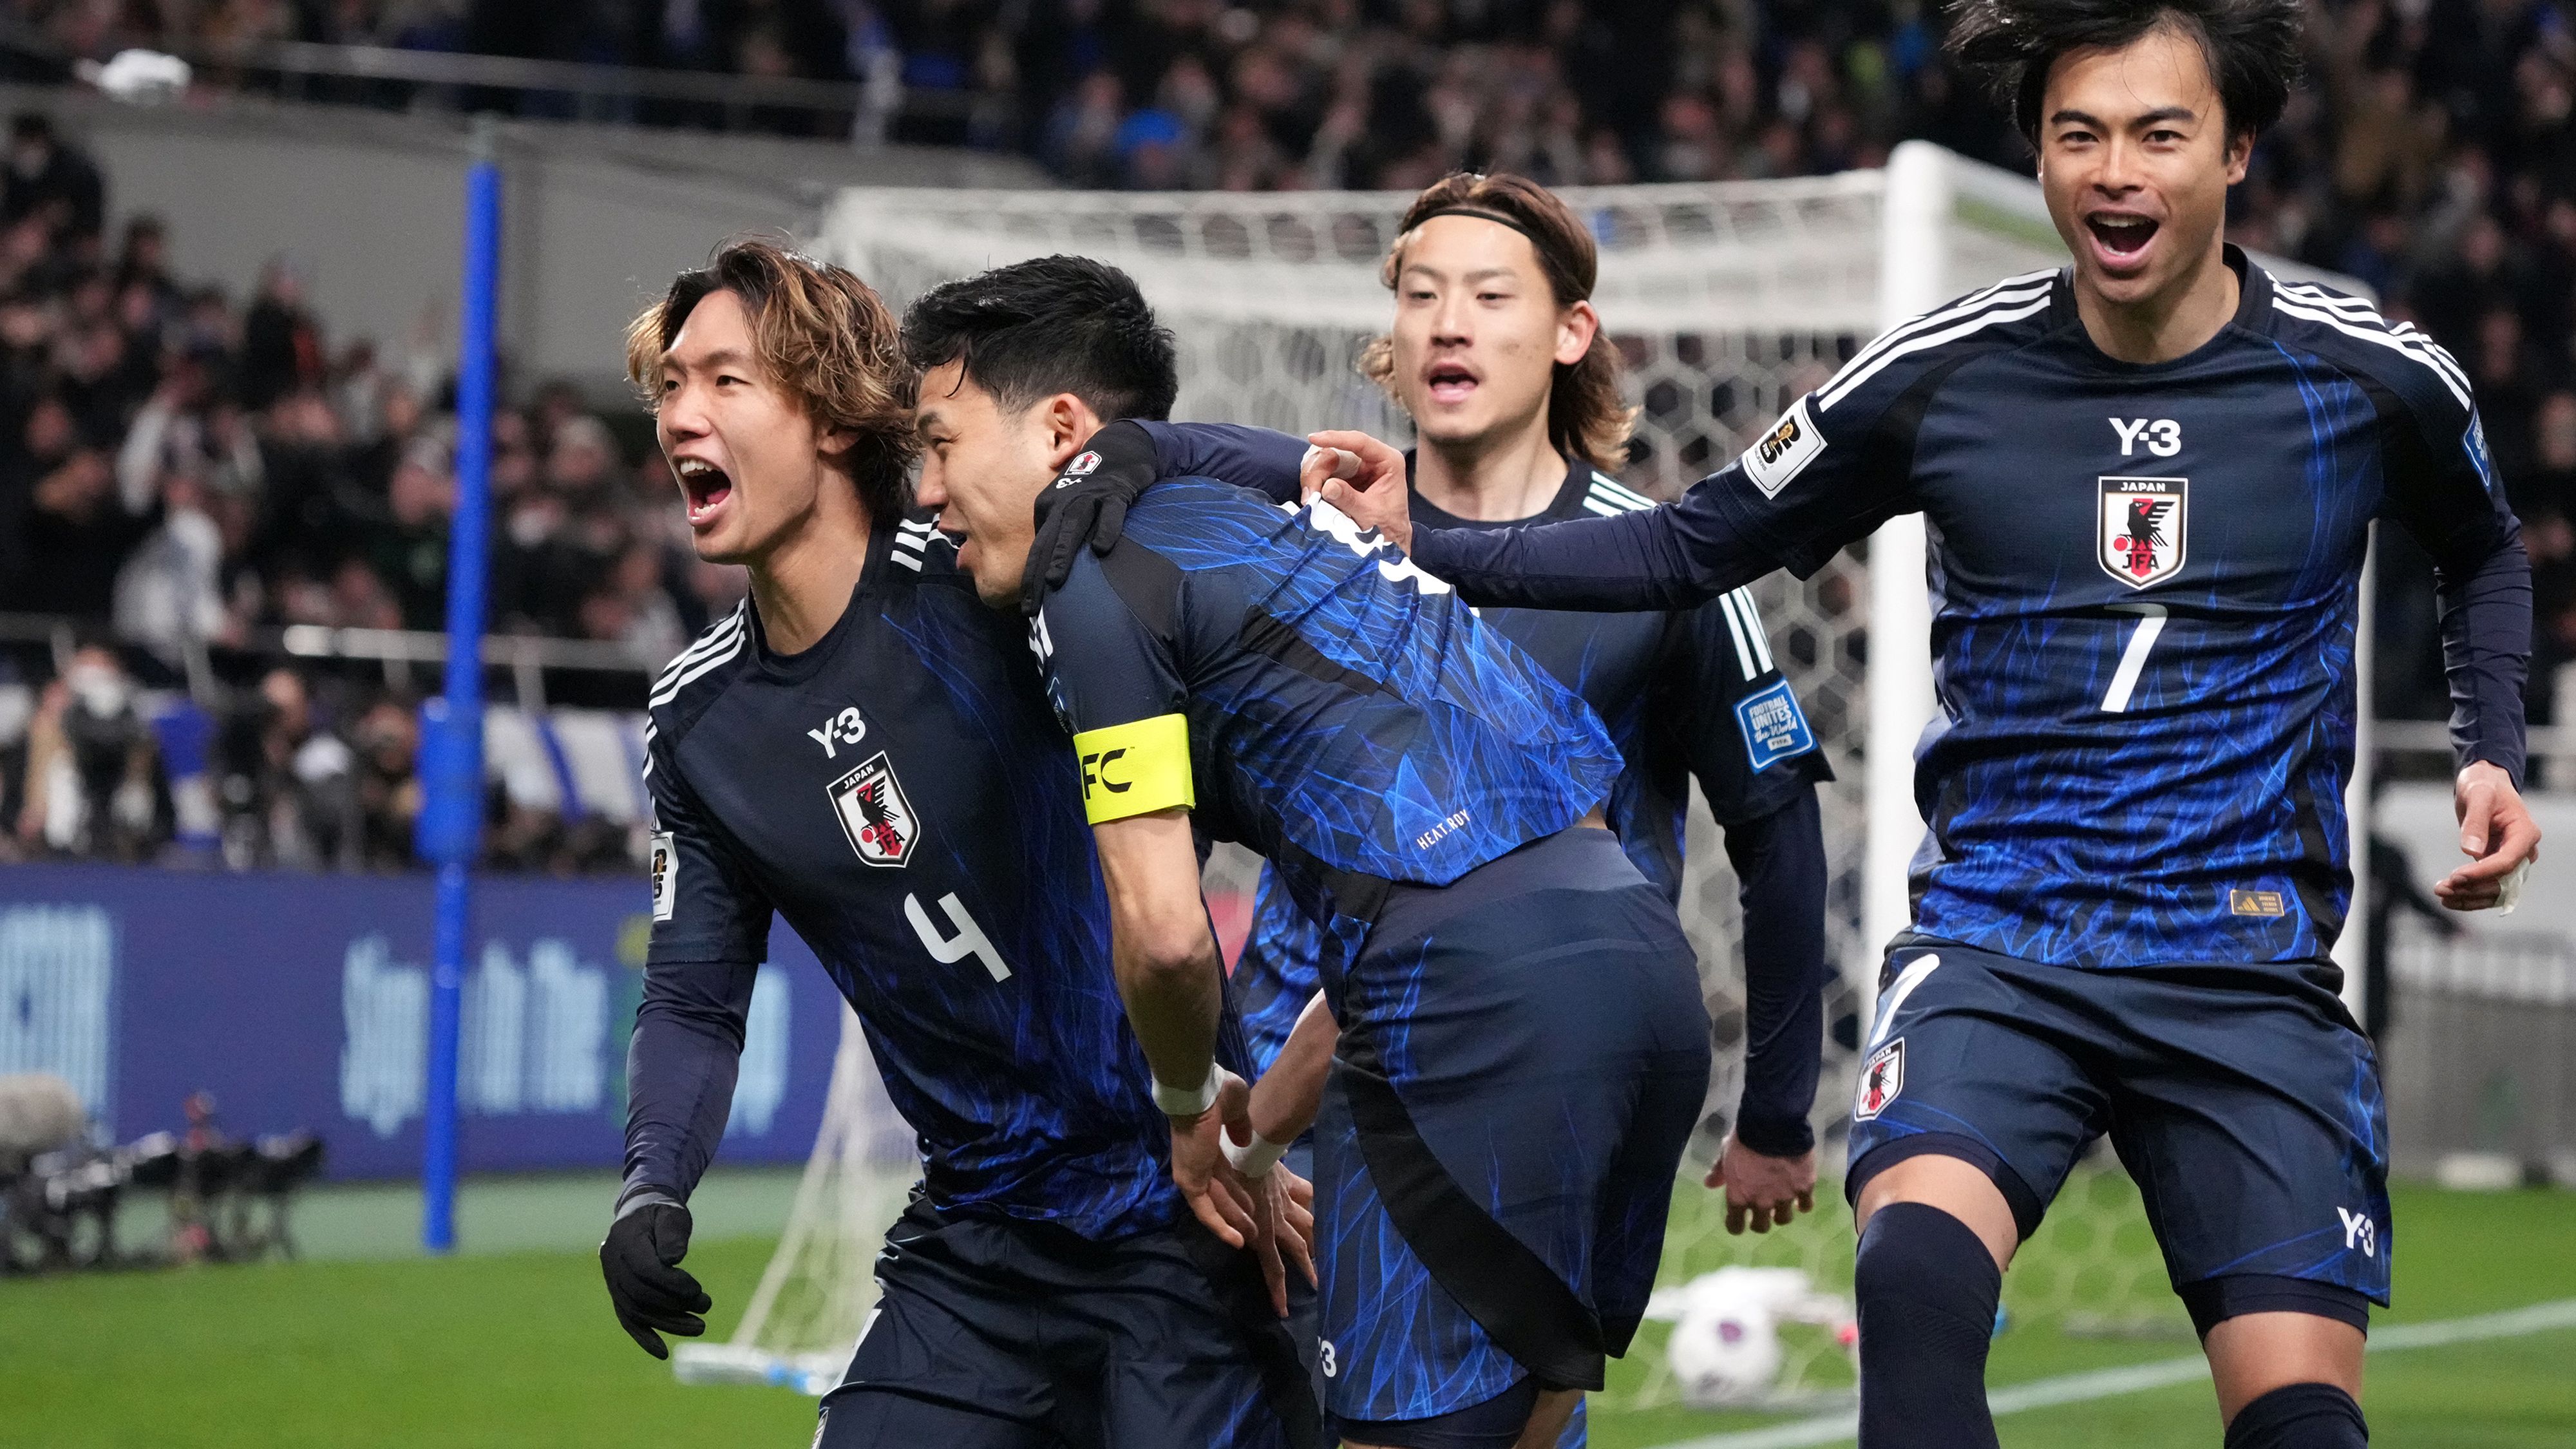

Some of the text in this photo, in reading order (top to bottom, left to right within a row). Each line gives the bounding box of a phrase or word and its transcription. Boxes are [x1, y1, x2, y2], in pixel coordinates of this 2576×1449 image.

[2108, 417, 2181, 457] Y-3
[2120, 482, 2166, 492] JAPAN
[2122, 554, 2160, 569] JFA
[2100, 602, 2168, 713] 7
[1748, 694, 1788, 718] FOOTBALL
[1752, 705, 1792, 731] UNITES
[806, 706, 866, 759] Y-3
[1754, 715, 1798, 744] the World
[844, 764, 875, 790] JAPAN
[875, 829, 906, 856] JFA
[1417, 809, 1470, 850] HEAT.RDY
[904, 891, 1012, 983] 4
[2336, 1206, 2374, 1258] Y-3
